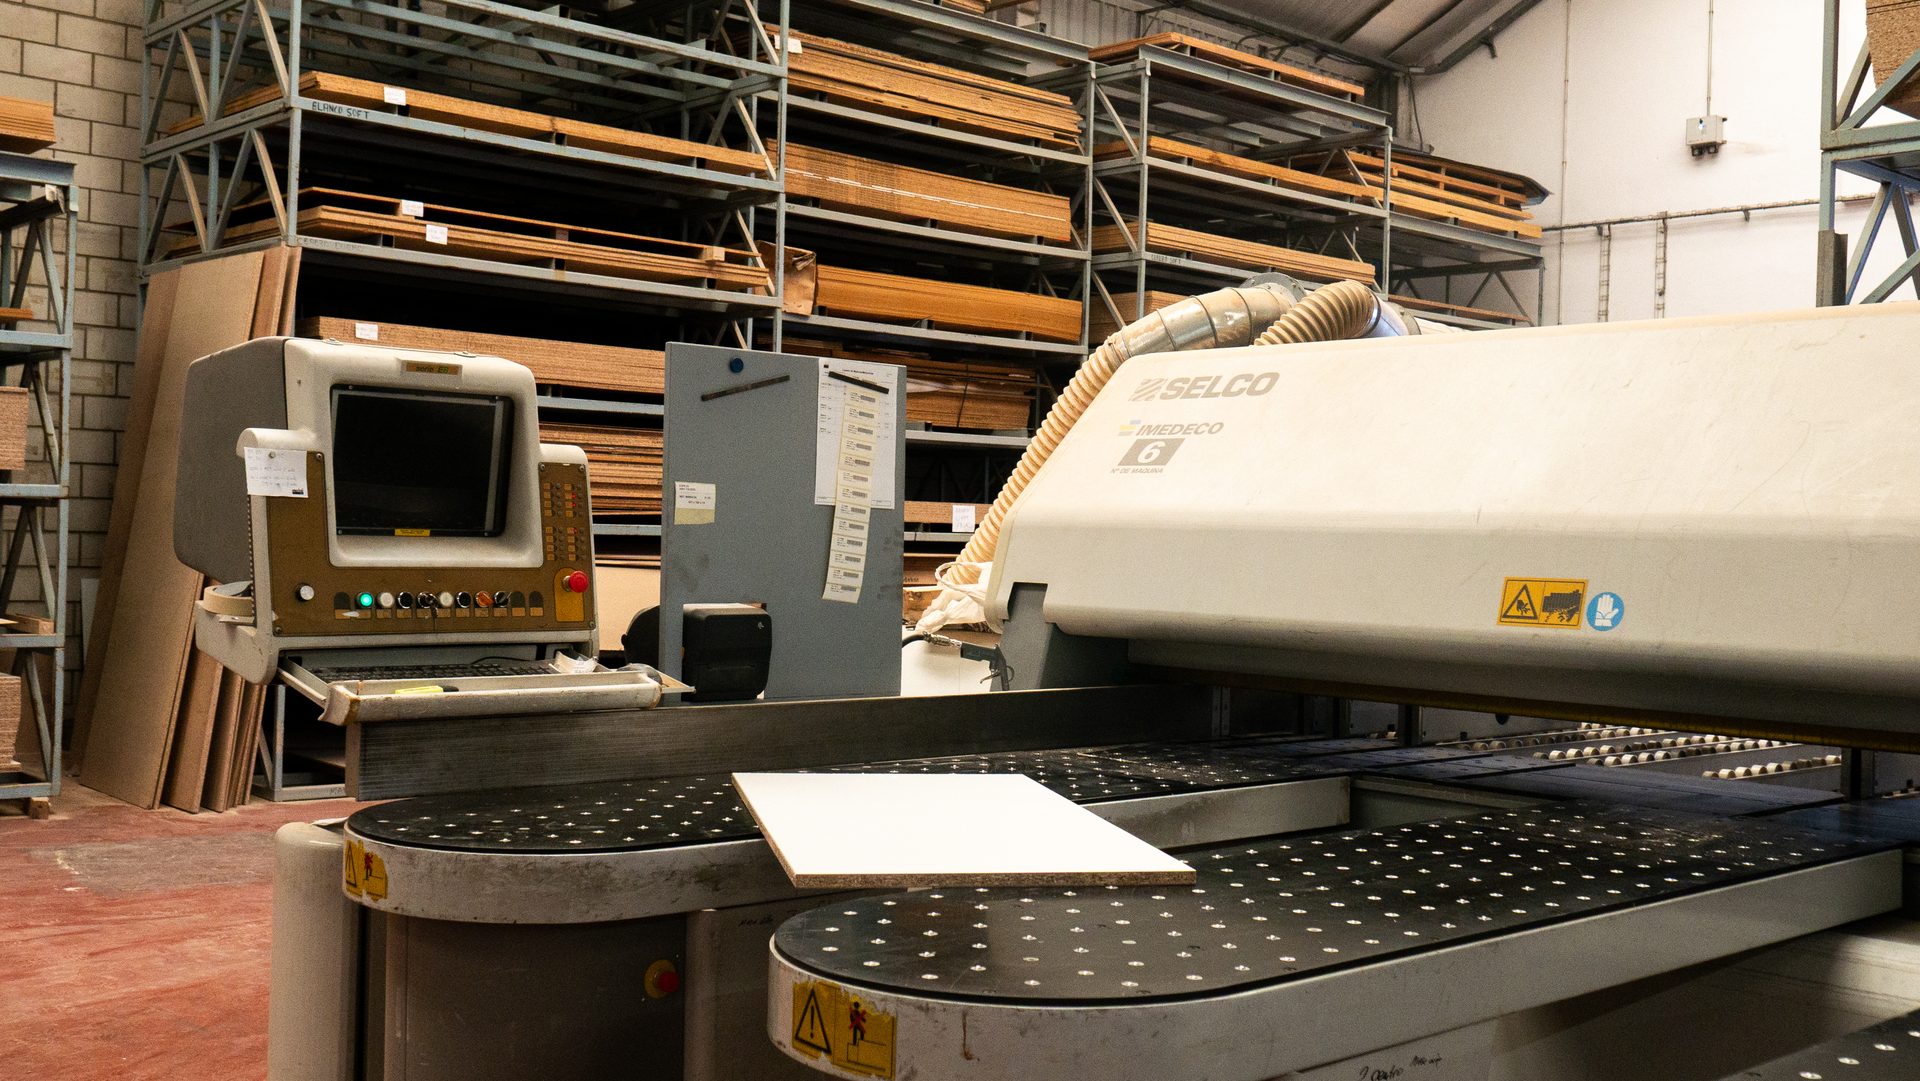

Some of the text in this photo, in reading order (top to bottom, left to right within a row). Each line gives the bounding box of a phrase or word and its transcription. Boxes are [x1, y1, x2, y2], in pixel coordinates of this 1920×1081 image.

[347, 108, 370, 119] SOFT
[1159, 372, 1280, 400] SELCO
[1136, 422, 1224, 436] IMEDECO
[1137, 440, 1166, 464] 6
